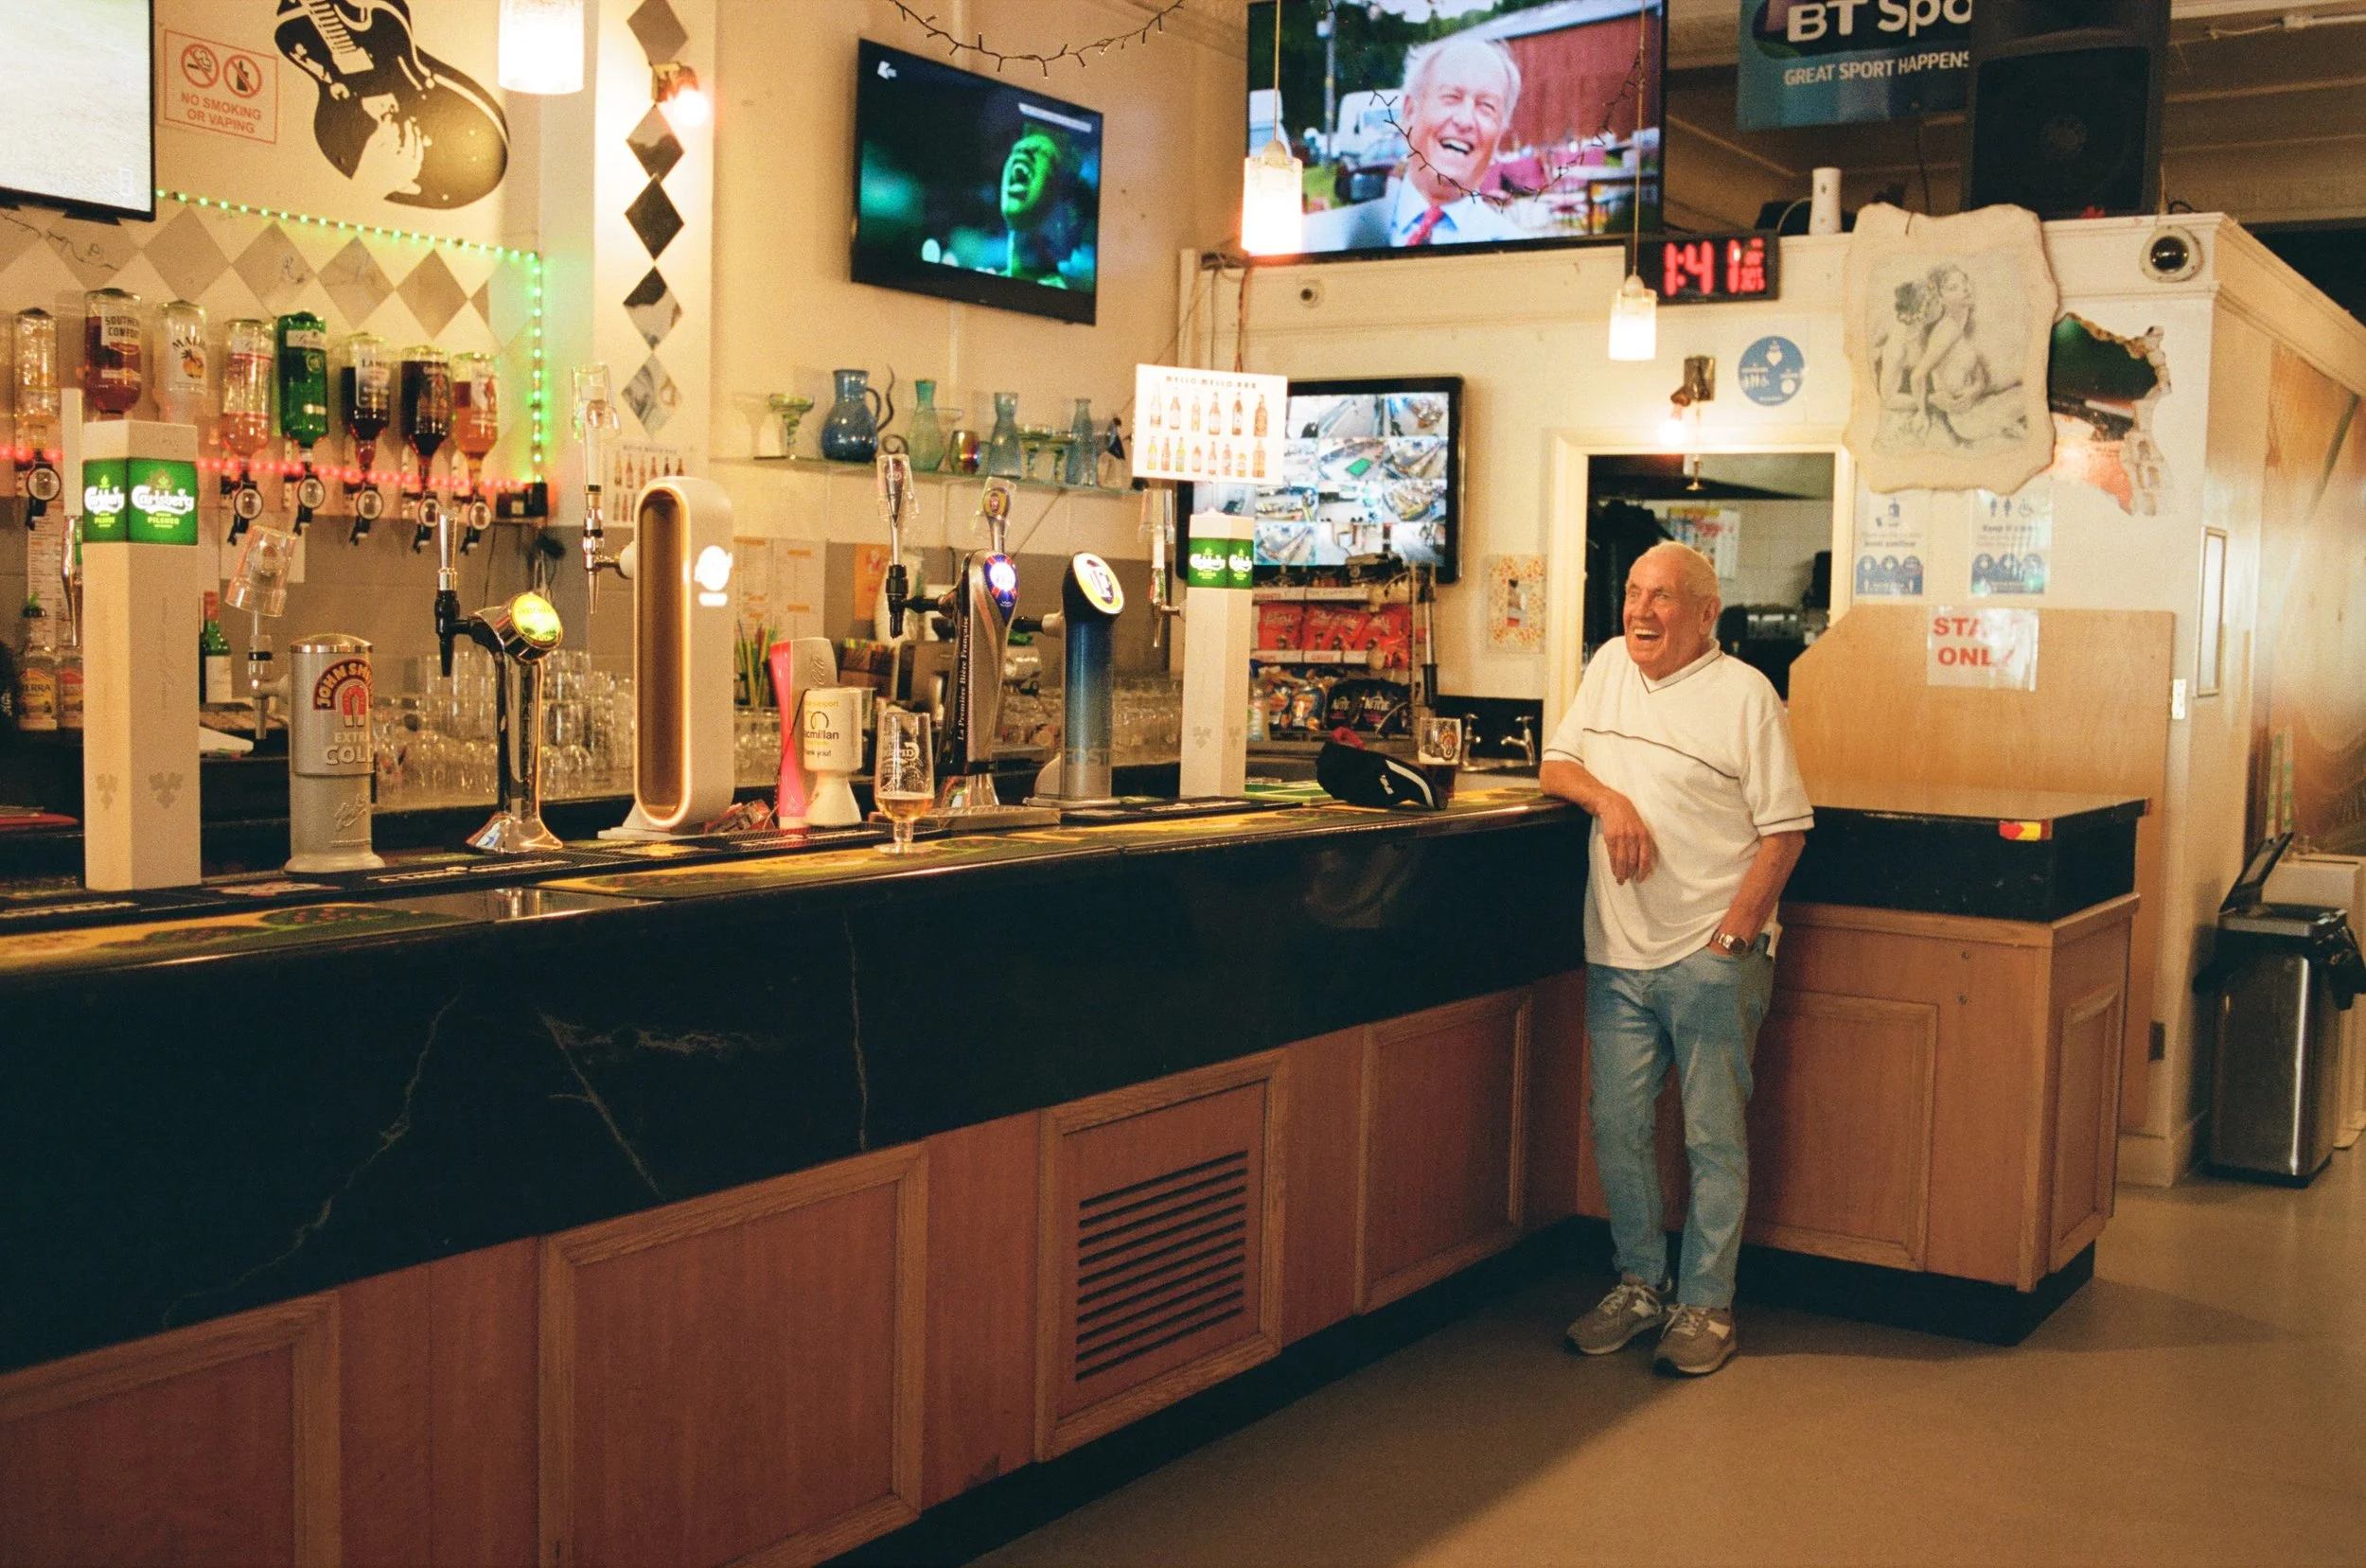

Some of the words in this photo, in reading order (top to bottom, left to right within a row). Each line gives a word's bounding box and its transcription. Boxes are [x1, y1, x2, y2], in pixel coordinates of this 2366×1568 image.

[1788, 0, 1869, 43] BT
[1878, 0, 1973, 37] Spo
[1785, 65, 1837, 85] GREAT
[1839, 61, 1895, 79] SPORT
[182, 92, 200, 106] NO
[203, 97, 261, 121] SMOKING
[187, 109, 205, 123] OR
[208, 114, 255, 133] VAPING
[132, 484, 195, 516] Carlsberg
[317, 664, 346, 708] JOHN
[335, 731, 368, 743] EXTR
